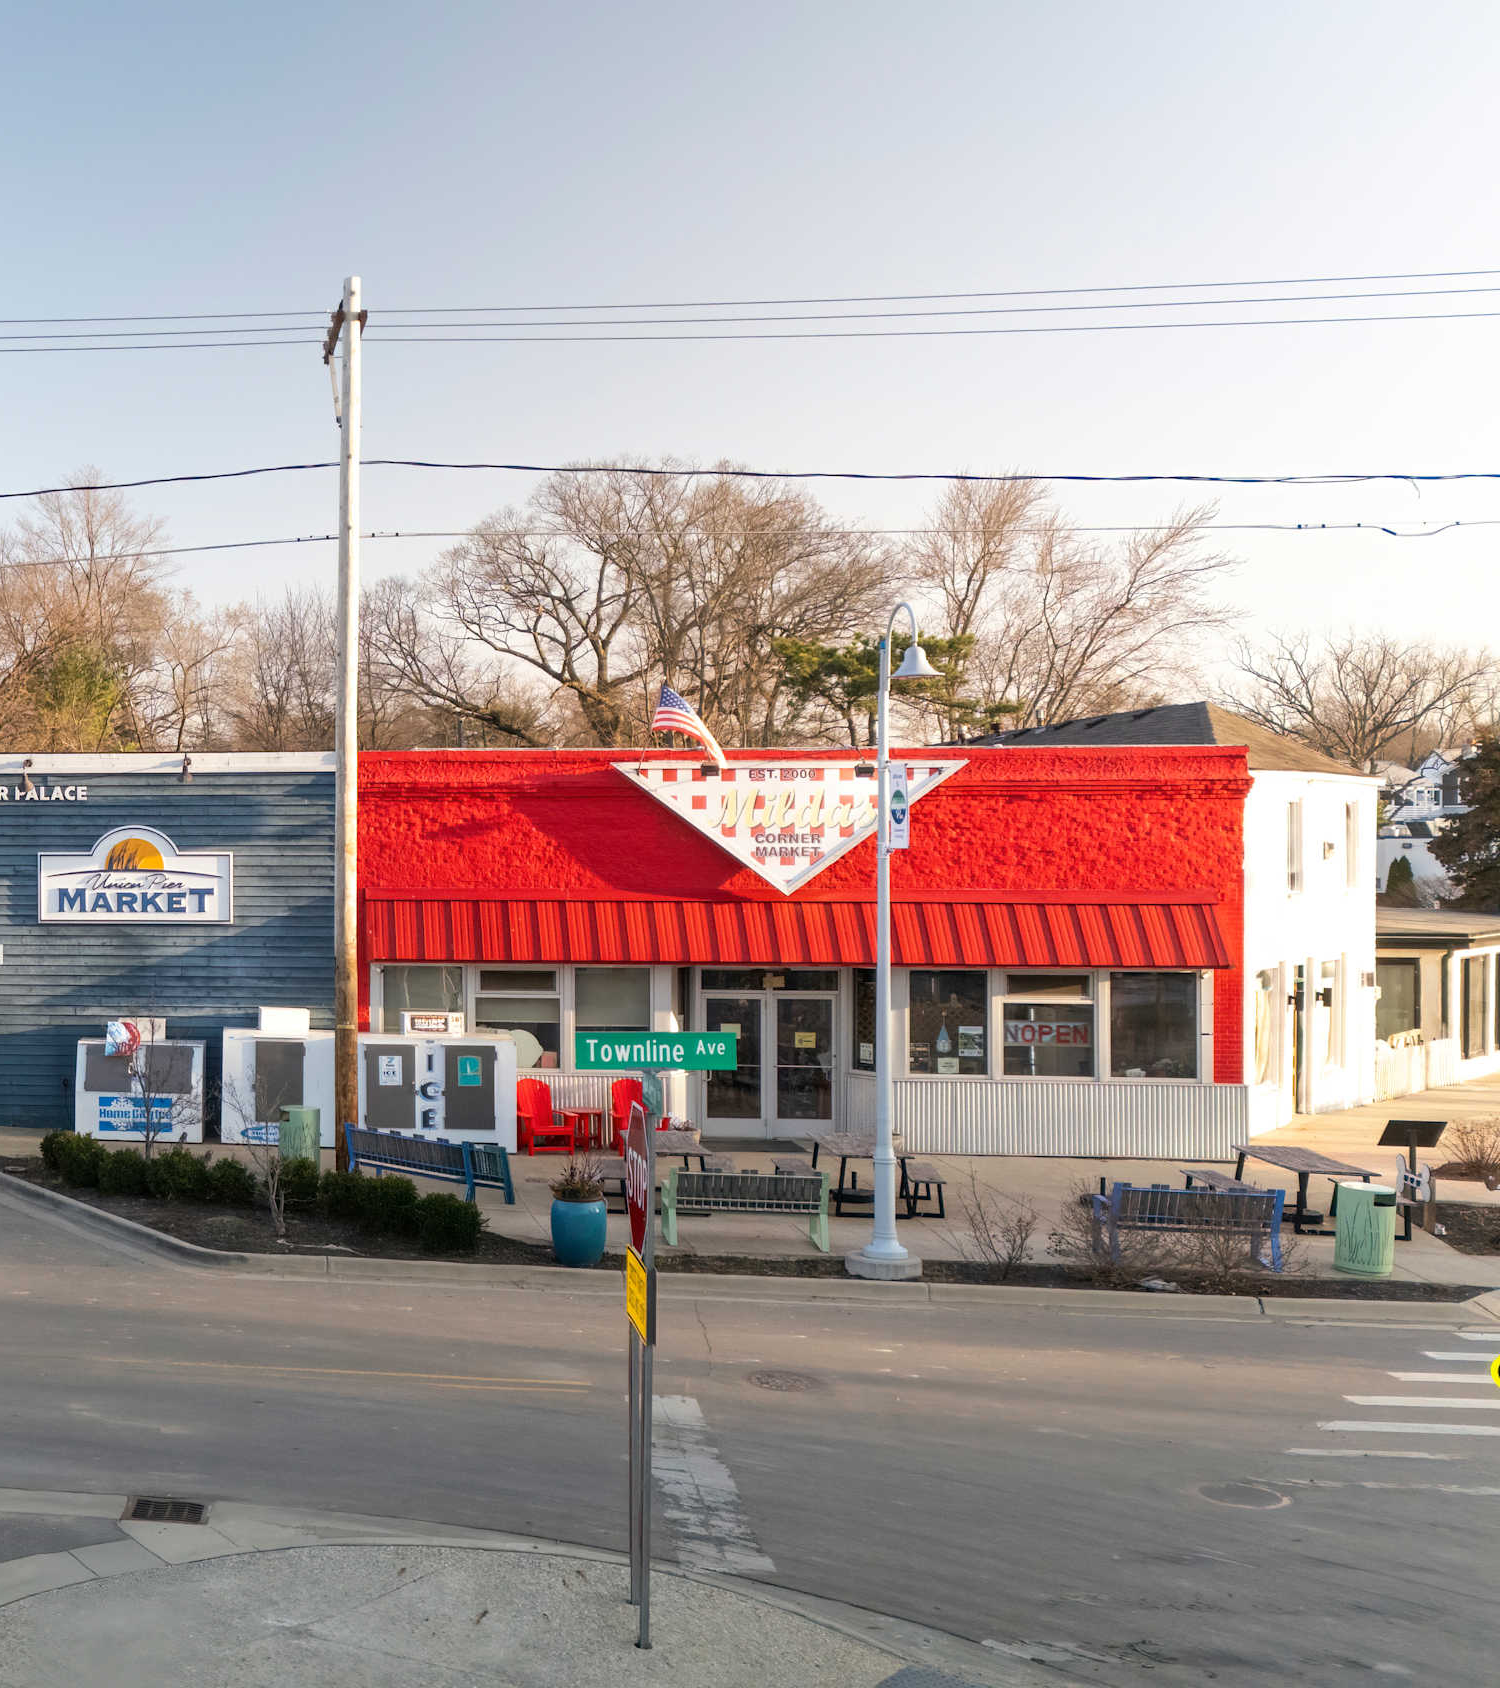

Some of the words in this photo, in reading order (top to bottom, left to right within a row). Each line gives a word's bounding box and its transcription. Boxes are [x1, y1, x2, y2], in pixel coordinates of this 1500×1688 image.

[749, 769, 777, 779] EST.
[779, 769, 816, 779] 2000
[15, 786, 88, 802] PALACE
[755, 833, 821, 844] CORNER
[755, 846, 821, 858] MARKET
[86, 873, 144, 890] Union
[147, 873, 185, 890] Pier
[58, 887, 215, 913] MARKET
[586, 1039, 685, 1063] Townline
[696, 1039, 726, 1056] Ave
[99, 1108, 131, 1120] Home
[627, 1147, 649, 1211] STOP
